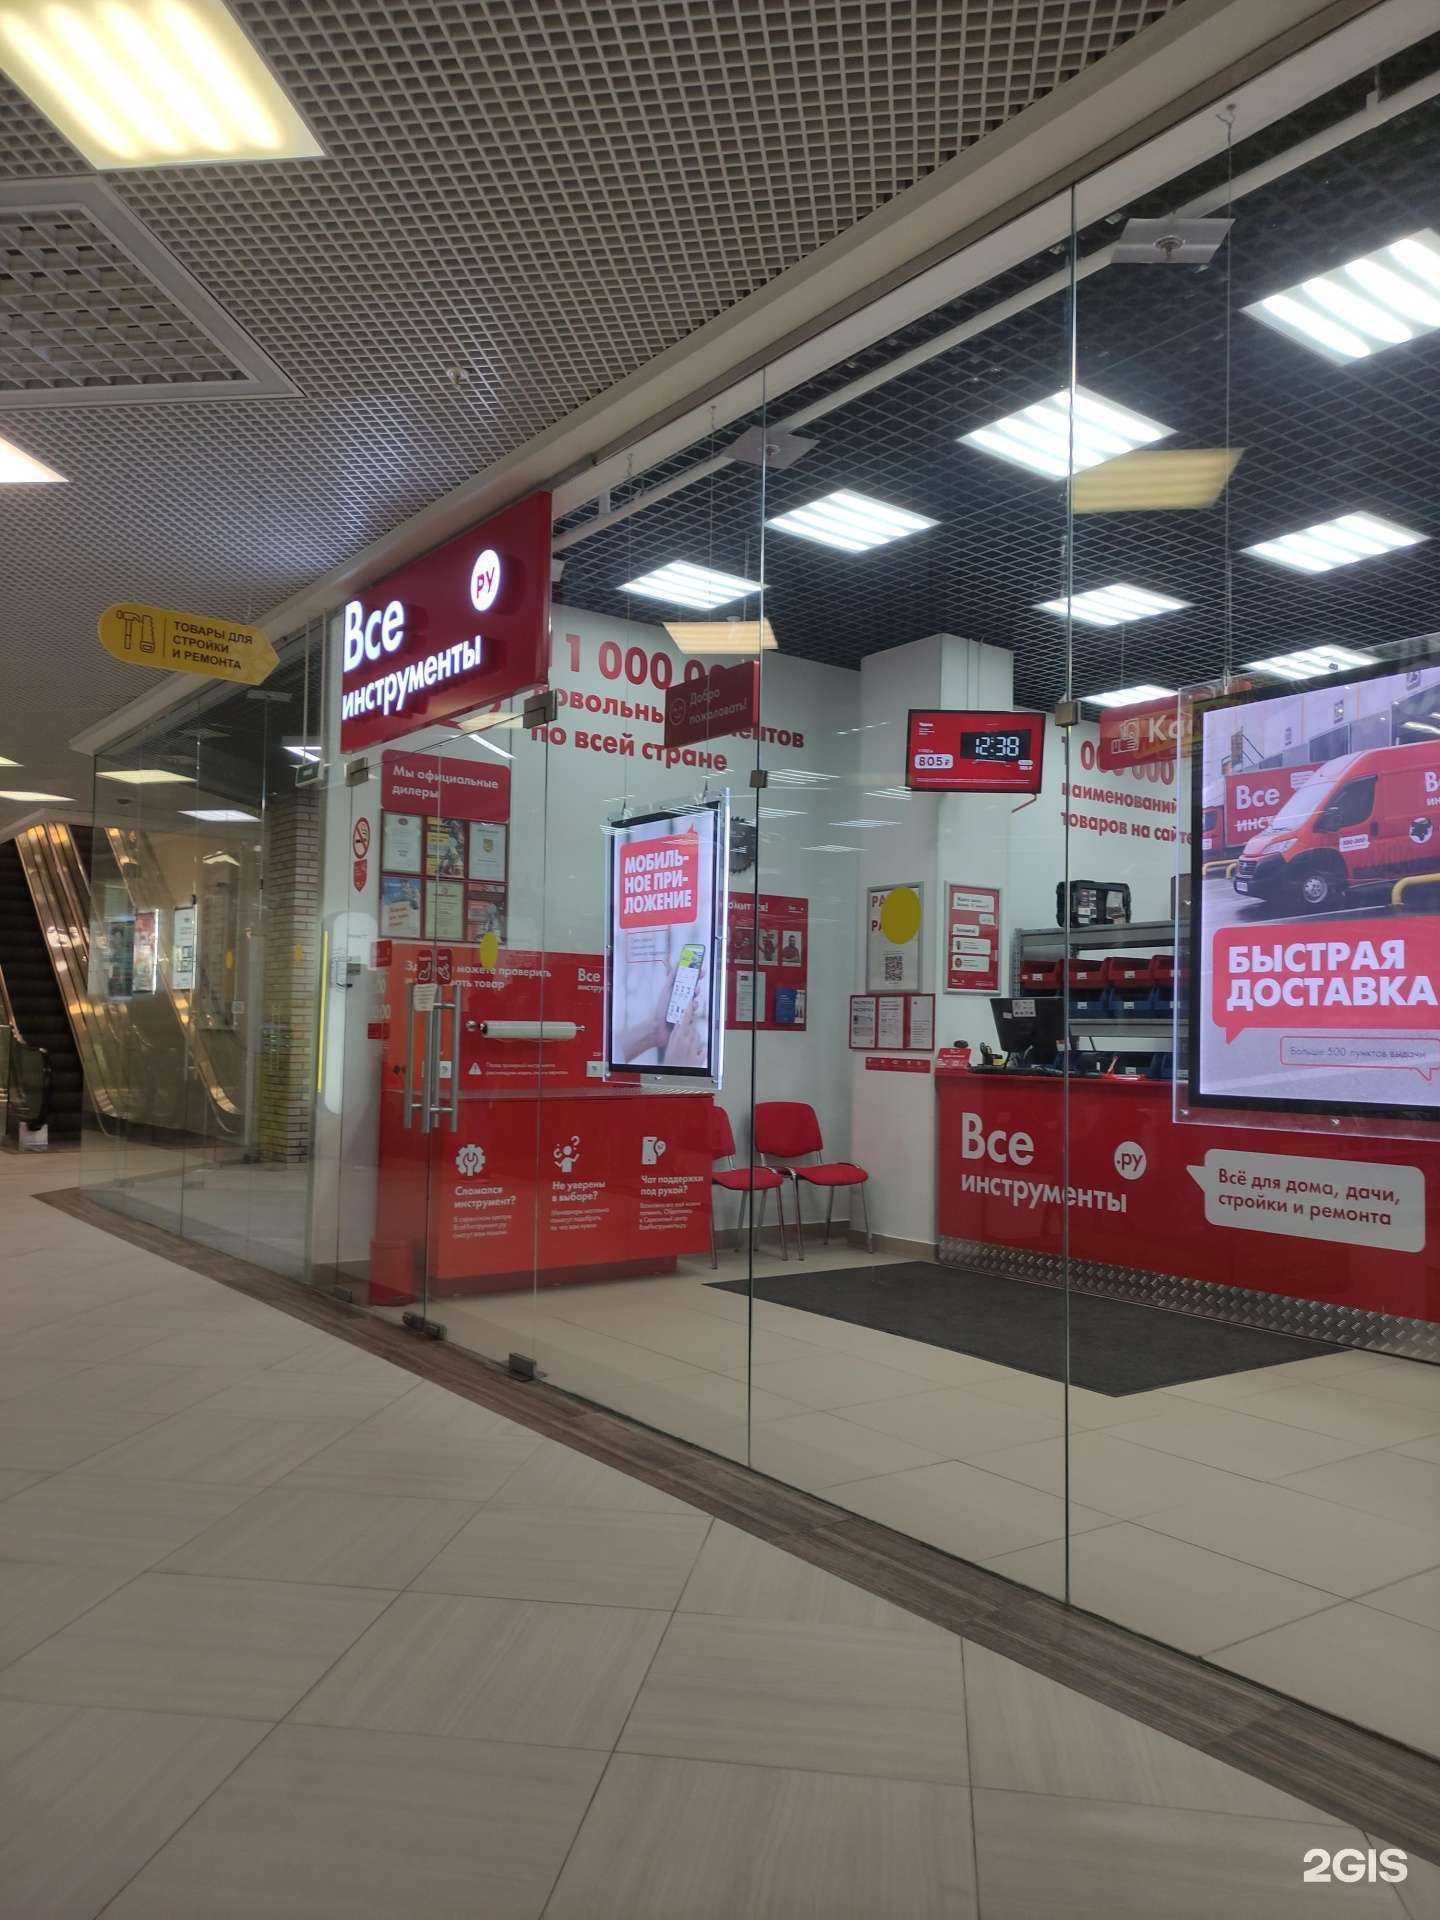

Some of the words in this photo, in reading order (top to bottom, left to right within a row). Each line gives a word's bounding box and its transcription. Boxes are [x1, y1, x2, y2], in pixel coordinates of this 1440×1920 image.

[172, 635, 230, 654] СТРОЙКИ
[173, 620, 226, 639] ТОВАРЫ
[228, 631, 254, 645] ДЛЯ
[344, 600, 405, 673] Все
[172, 649, 181, 659] И
[184, 650, 242, 670] РЕМОНТА
[598, 640, 673, 690] 000
[341, 635, 482, 721] инструменты
[689, 688, 721, 706] Добро
[531, 725, 567, 746] по
[574, 731, 635, 757] всей
[641, 742, 729, 772] стране
[392, 765, 415, 780] Мы
[417, 769, 500, 790] официальные
[391, 785, 440, 800] дилеры
[1060, 811, 1128, 836] товаров
[1131, 823, 1151, 839] на
[624, 849, 690, 875] МОБИЛЬ-
[624, 876, 653, 895] НОЕ
[653, 873, 690, 892] ПРИ-
[623, 889, 693, 915] ЛОЖЕНИЕ
[1227, 939, 1406, 974] БЫСТРАЯ
[475, 980, 506, 991] товар
[498, 967, 553, 980] проверить
[577, 968, 601, 982] Все
[1226, 975, 1439, 1012] ДОСТАВКА
[961, 1111, 1035, 1167] Все
[566, 1180, 607, 1192] уверены
[640, 1187, 654, 1197] под
[960, 1174, 1128, 1213] инструменты
[1218, 1167, 1247, 1187] Всё
[1251, 1173, 1282, 1193] для
[1285, 1177, 1341, 1199] дома,
[1345, 1182, 1401, 1204] дачи,
[454, 1195, 518, 1210] инструмент?
[1218, 1193, 1289, 1214] стройки
[1292, 1202, 1305, 1215] и
[1309, 1204, 1392, 1227] ремонта
